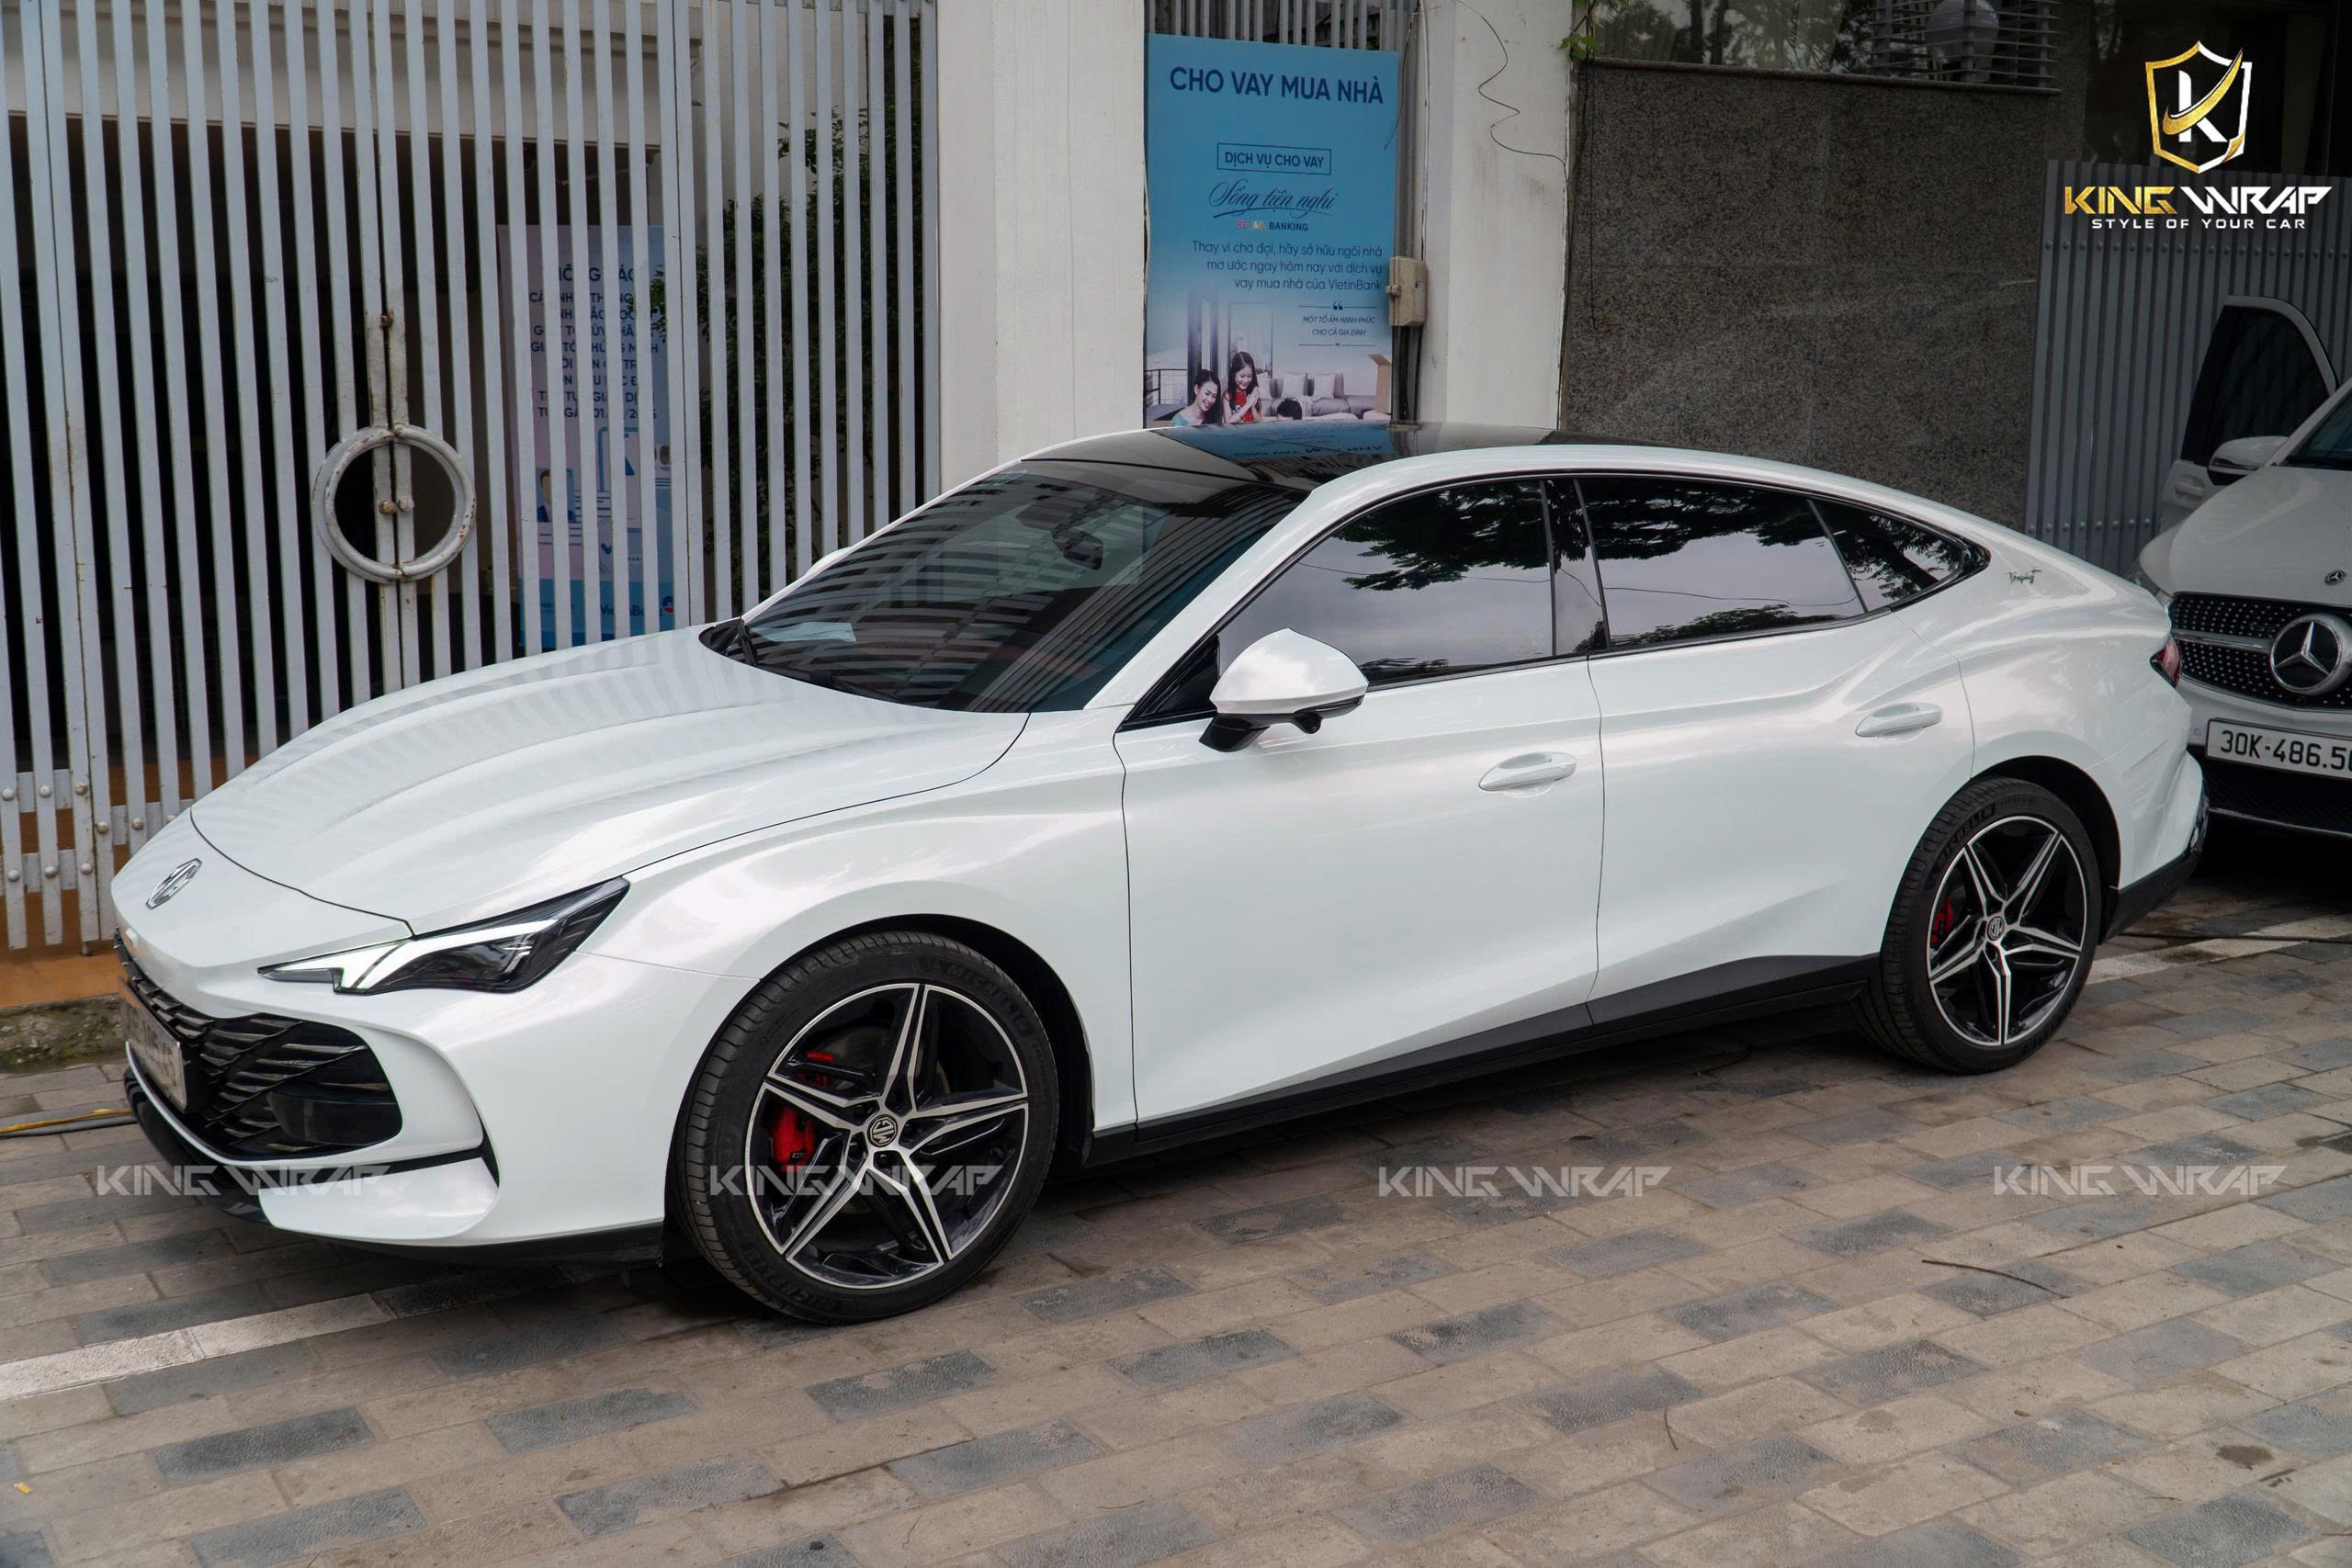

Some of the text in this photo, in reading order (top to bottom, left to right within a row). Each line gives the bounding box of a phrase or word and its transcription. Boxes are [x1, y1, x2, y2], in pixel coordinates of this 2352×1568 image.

[1170, 66, 1384, 104] CHO VAY MUA NHÀ
[1225, 152, 1325, 169] DỊCH VỤ CHO VAY
[1209, 177, 1339, 219] Sống tiện nghi
[1269, 221, 1309, 231] BANKING
[1191, 240, 1219, 255] Thay
[1279, 243, 1298, 256] hãy
[1338, 244, 1361, 259] ngôi
[1250, 261, 1277, 274] ngay
[1280, 261, 1303, 272] hôm
[1306, 264, 1325, 275] nay
[1329, 262, 1343, 273] với
[1345, 263, 1368, 276] dịch
[1234, 278, 1254, 291] vay
[1256, 279, 1281, 289] mua
[1306, 277, 1326, 290] của
[1329, 278, 1382, 291] VietinBank
